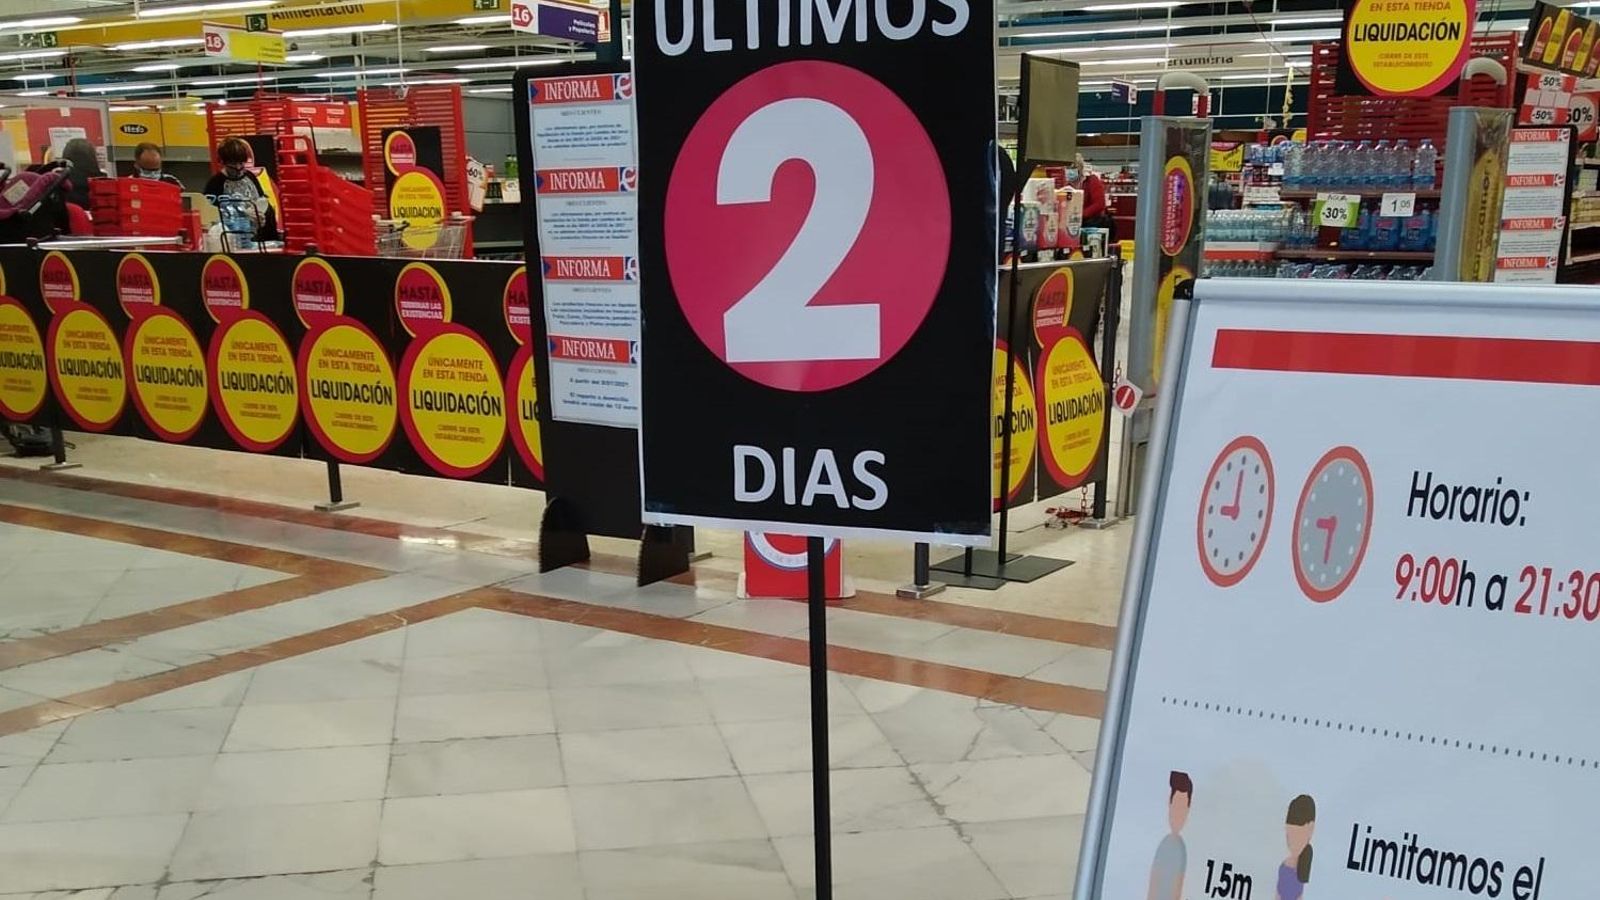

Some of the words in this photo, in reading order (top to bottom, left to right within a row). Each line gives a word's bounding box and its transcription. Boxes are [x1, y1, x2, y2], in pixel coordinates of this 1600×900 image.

[513, 8, 530, 22] 16
[1370, 3, 1382, 12] EN
[1387, 2, 1410, 12] ESTA
[1414, 1, 1451, 11] TIENDA
[1354, 17, 1461, 42] LIQUIDACIÓN
[206, 36, 221, 48] 18
[544, 80, 600, 100] INFORMA
[1514, 131, 1550, 141] INFORMA
[550, 171, 605, 190] INFORMA
[1510, 175, 1545, 185] INFORMA
[1322, 207, 1347, 220] -30%
[716, 97, 880, 363] 2
[1509, 219, 1544, 229] INFORMA
[556, 259, 611, 277] INFORMA
[1503, 258, 1538, 268] INFORMA
[562, 340, 616, 359] INFORMA
[58, 356, 122, 379] LIQUIDACIÓN
[428, 355, 483, 370] ÚNICAMENTE
[136, 364, 204, 387] LIQUIDACIÓN
[221, 370, 295, 395] LIQUIDACIÓN
[423, 369, 433, 378] EN
[436, 370, 455, 380] ESTA
[459, 371, 488, 382] TIENDA
[311, 379, 393, 406] LIQUIDACIÓN
[413, 389, 501, 417] LIQUIDACIÓN
[1048, 388, 1103, 425] LIQUIDACIÓN
[733, 444, 888, 511] DIAS
[1406, 470, 1530, 526] Horario:
[1395, 553, 1476, 607] 9:00h
[1485, 574, 1508, 611] a
[1514, 565, 1600, 621] 21:30
[1346, 823, 1504, 899] Limitamos
[1513, 857, 1545, 900] el
[1205, 859, 1252, 900] 1,5m
